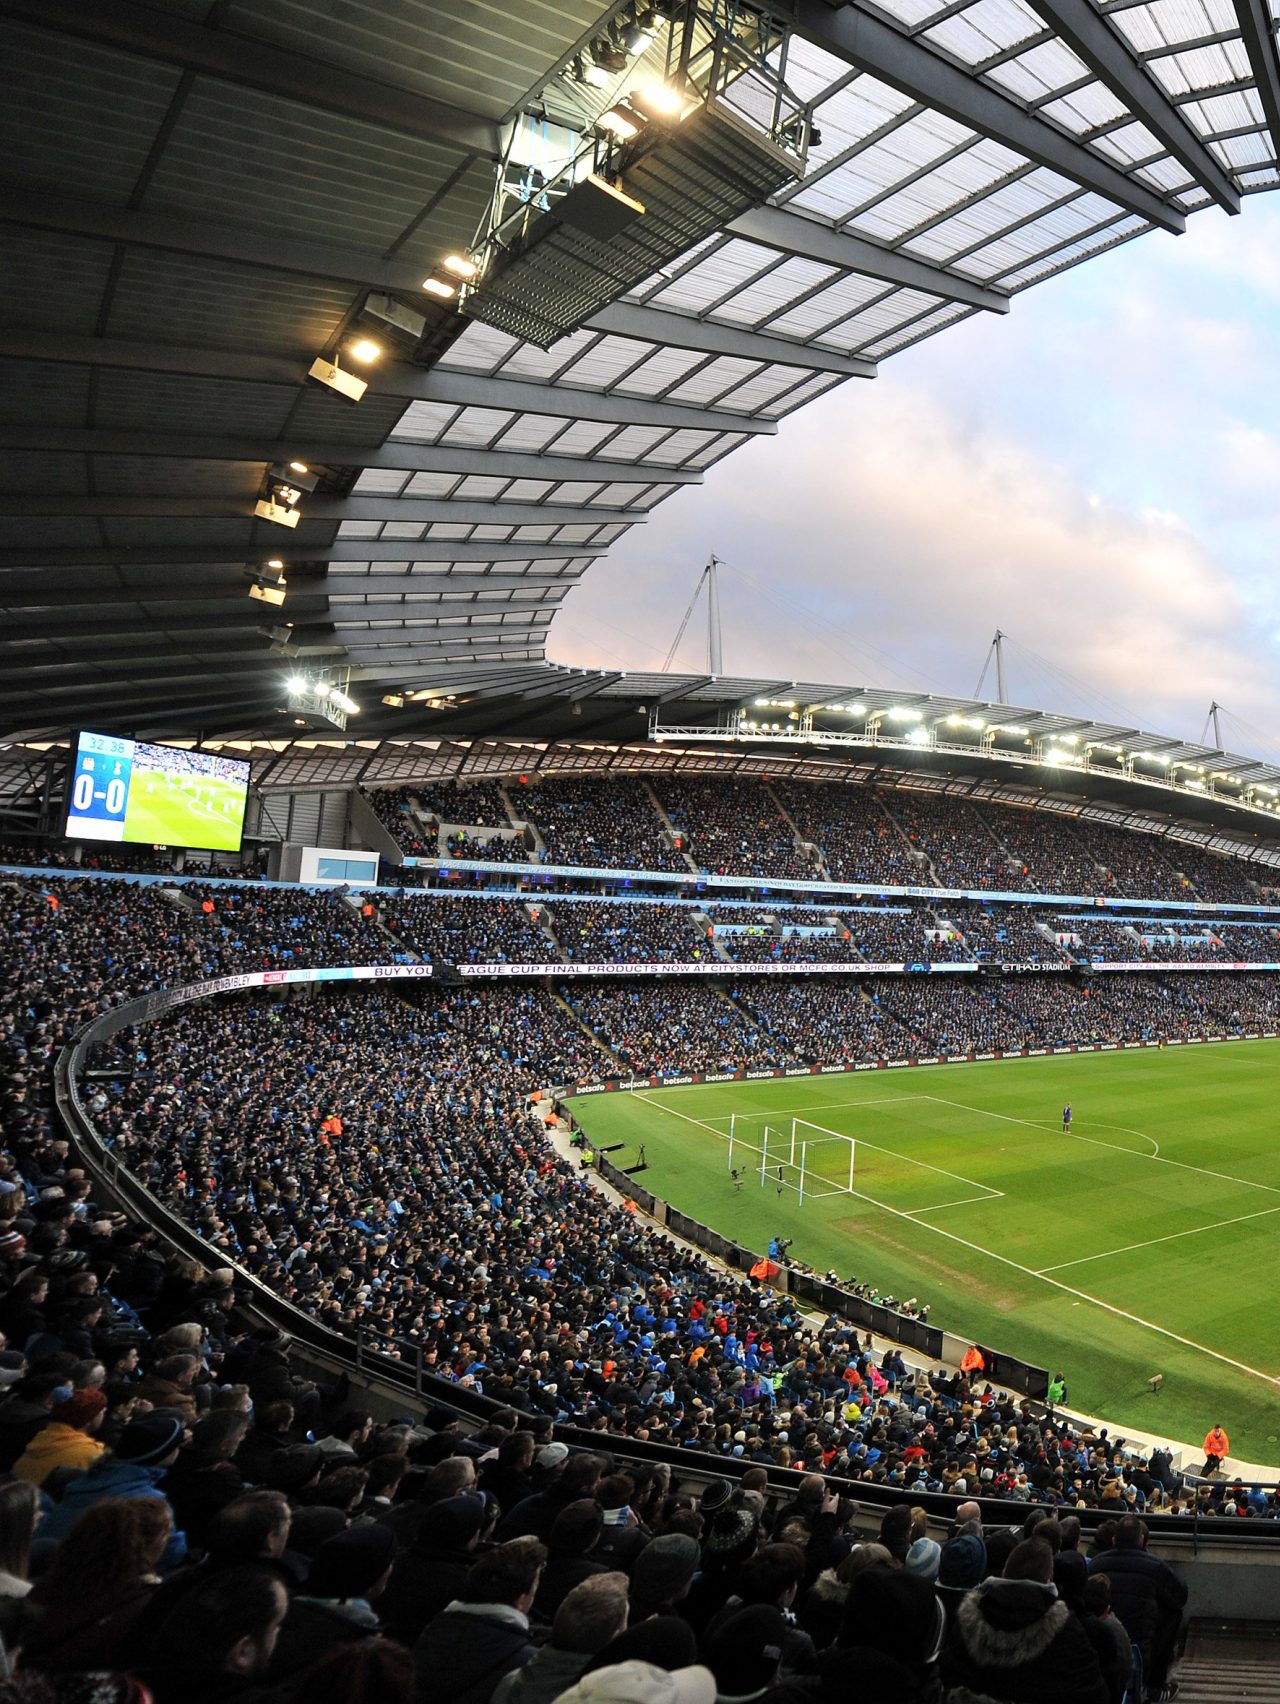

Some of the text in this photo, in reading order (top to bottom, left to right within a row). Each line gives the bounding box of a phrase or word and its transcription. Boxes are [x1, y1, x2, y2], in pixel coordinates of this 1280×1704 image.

[73, 773, 126, 814] 0-0
[374, 967, 401, 976] BUY
[510, 965, 540, 974] CUP
[545, 965, 583, 973] FINAL
[588, 965, 658, 973] PRODUCTS
[662, 964, 690, 972] NOW
[693, 964, 707, 972] AT
[711, 964, 778, 972] CITYSTORES
[1001, 963, 1071, 971] ETIHAD STADIUM
[975, 1052, 995, 1060] betsafe
[855, 1061, 878, 1069] betsafe
[887, 1059, 909, 1067] betsafe
[918, 1057, 939, 1065] betsafe
[785, 1067, 811, 1076] betsafe
[821, 1064, 845, 1073] betsafe
[705, 1072, 734, 1082] betsafe
[746, 1069, 774, 1079] betsafe
[619, 1077, 650, 1089] betsafe
[663, 1074, 692, 1085] betsafe
[576, 1082, 605, 1094] betsafe
